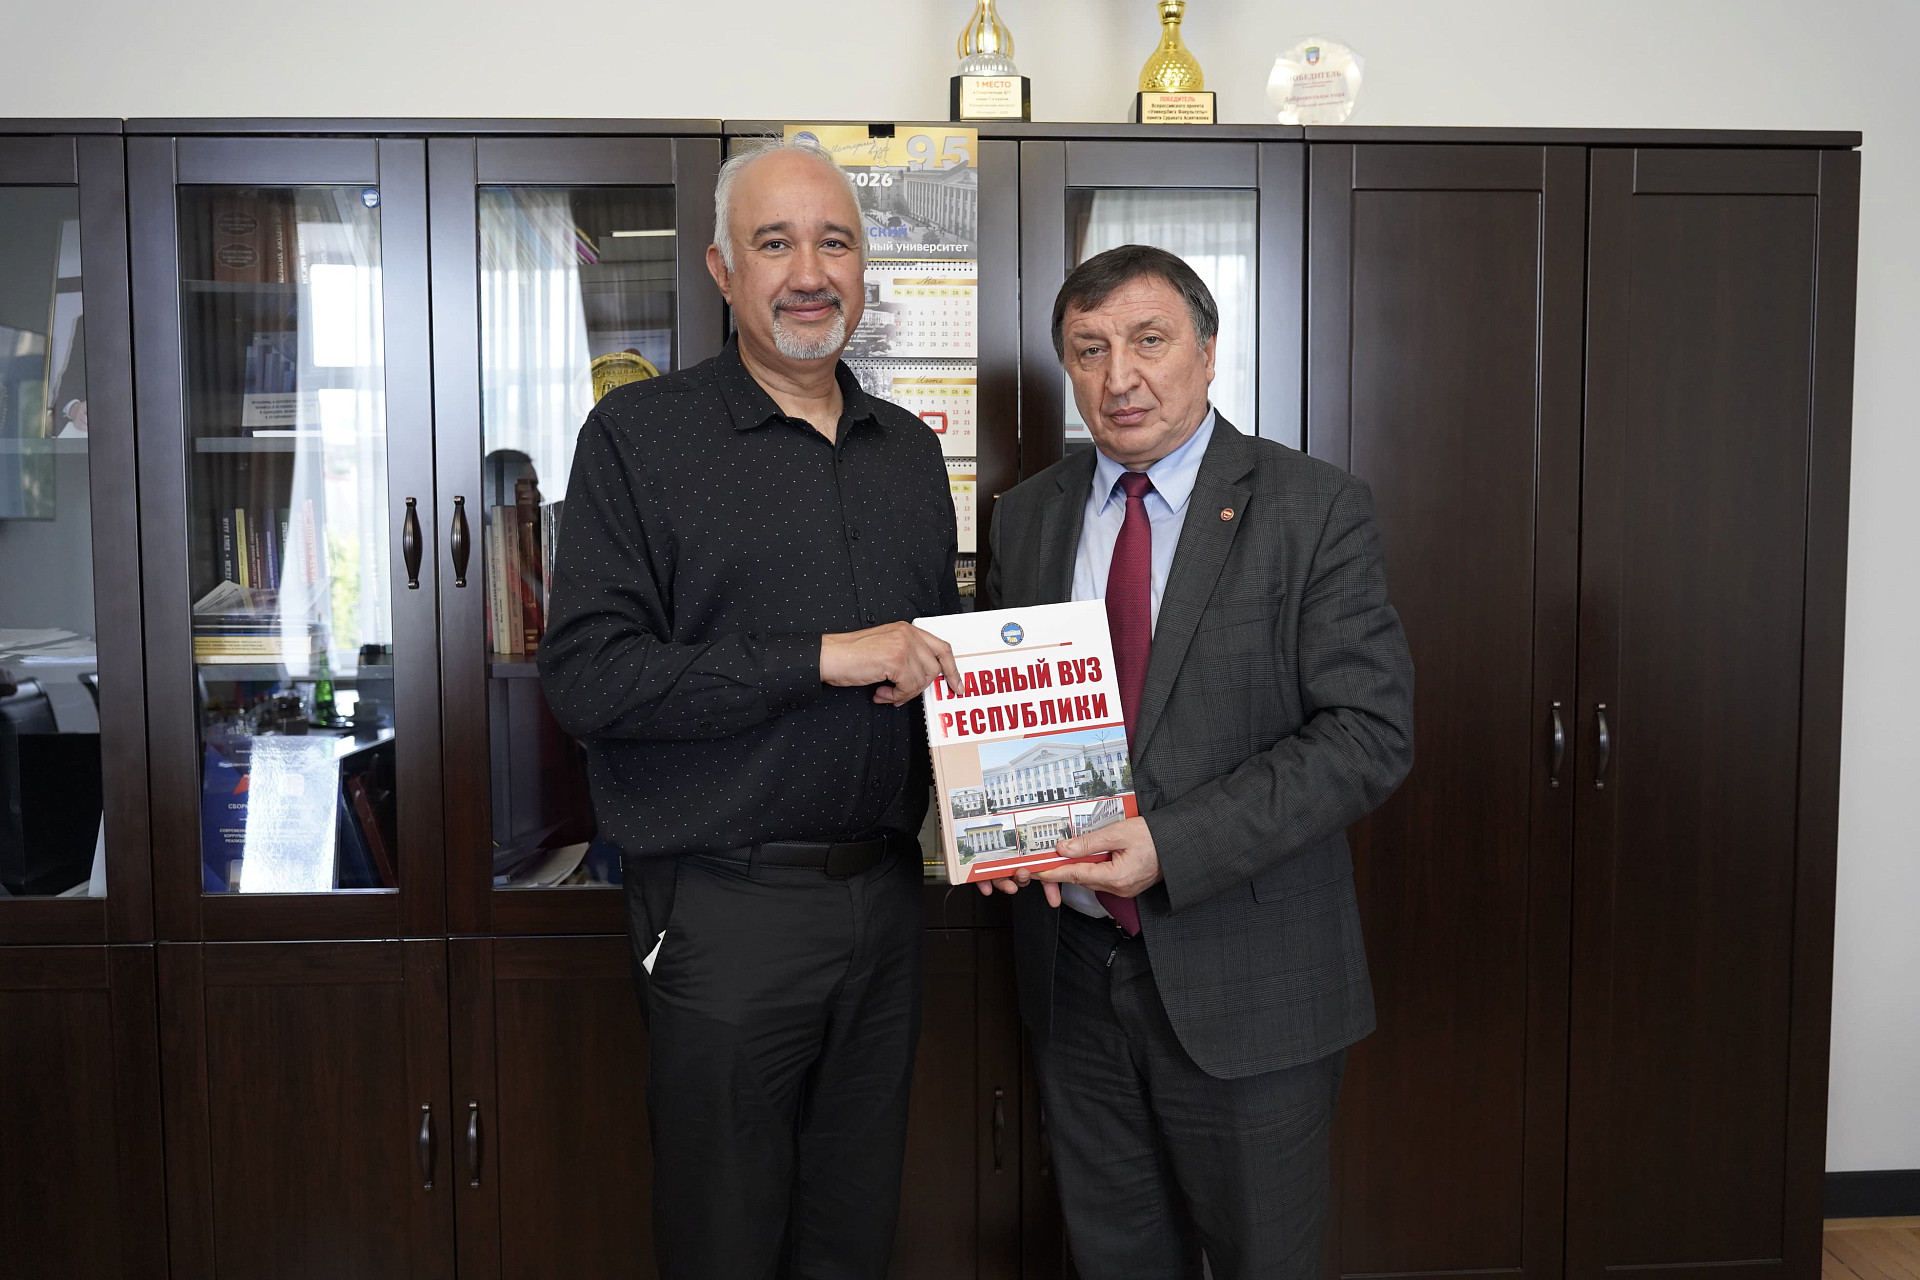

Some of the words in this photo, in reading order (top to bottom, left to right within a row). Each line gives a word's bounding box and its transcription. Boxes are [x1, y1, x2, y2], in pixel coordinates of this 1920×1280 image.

[1290, 71, 1342, 81] ОБЕДИТЕЛЬ
[907, 134, 970, 171] 95
[896, 243, 968, 253] университет
[1057, 656, 1103, 686] ВУЗ
[938, 693, 1109, 738] РЕСПУБЛИКИ
